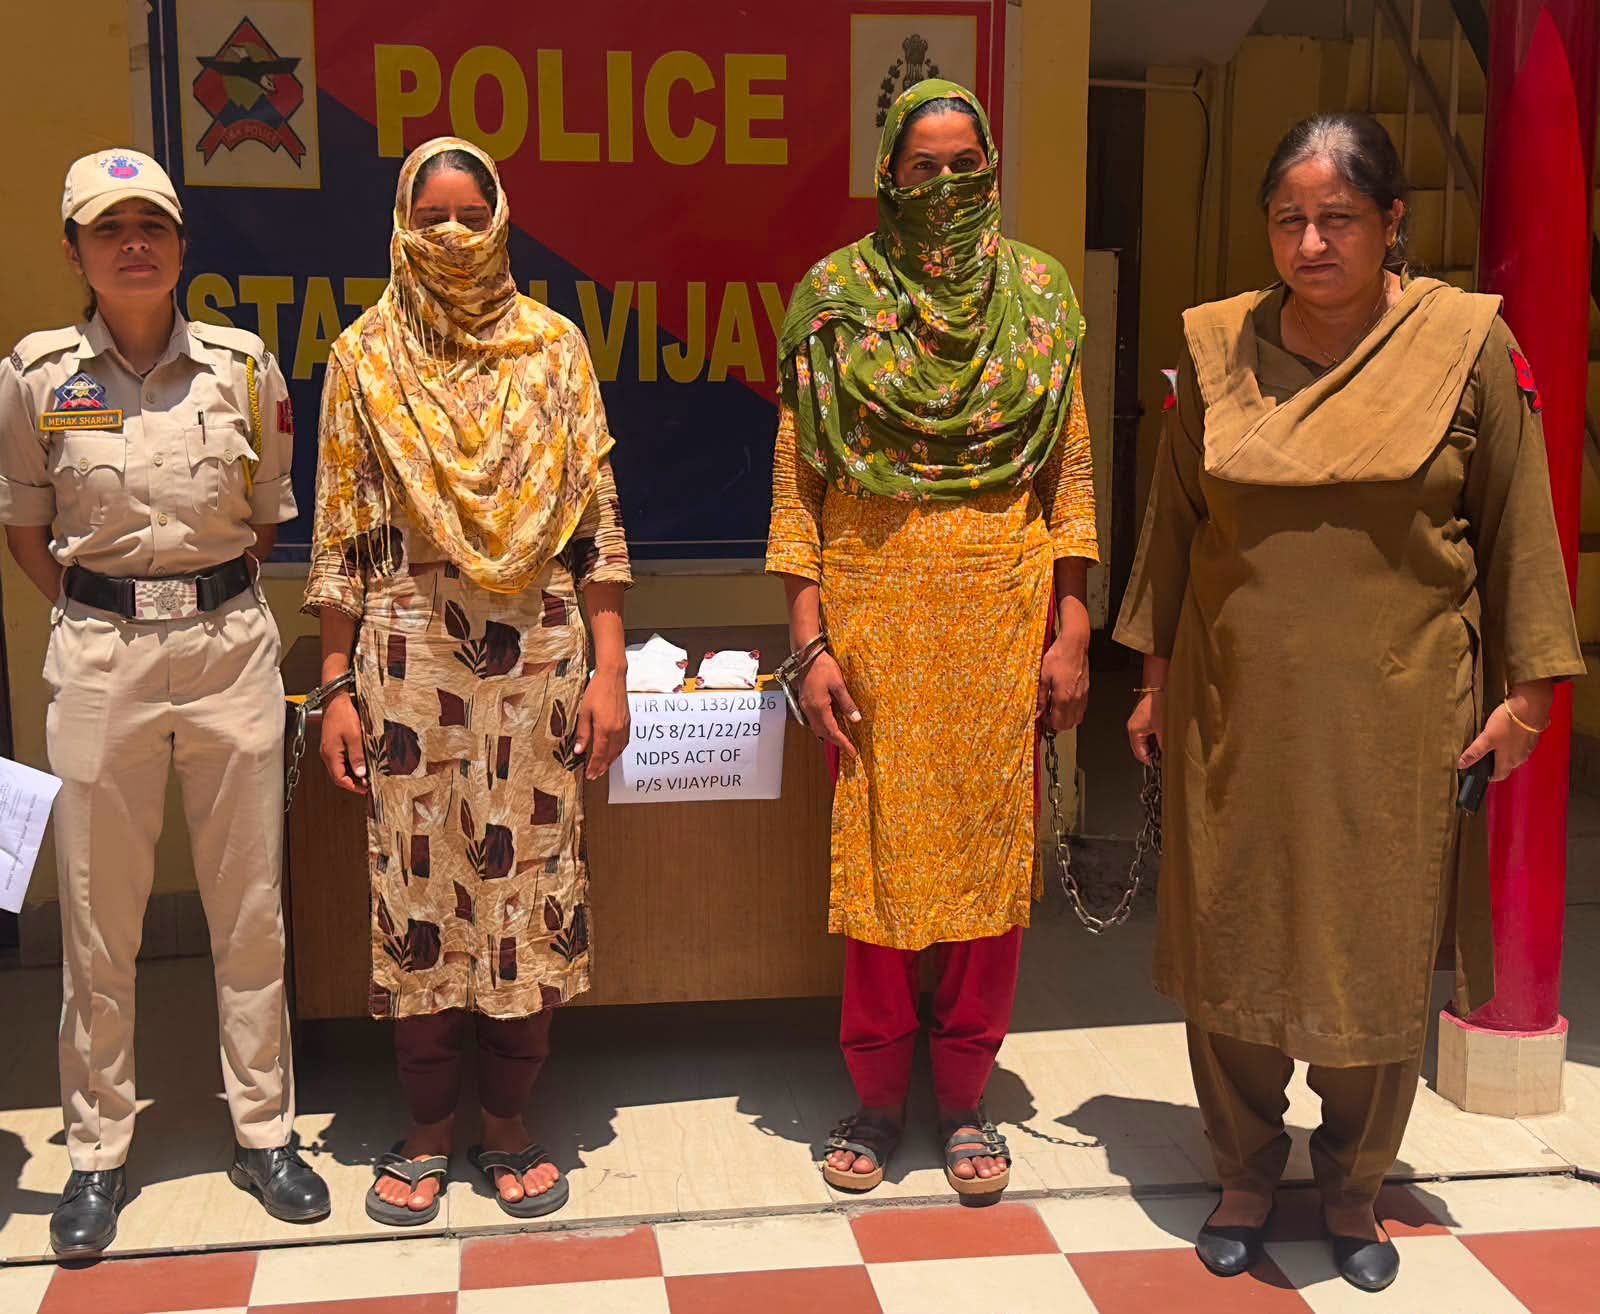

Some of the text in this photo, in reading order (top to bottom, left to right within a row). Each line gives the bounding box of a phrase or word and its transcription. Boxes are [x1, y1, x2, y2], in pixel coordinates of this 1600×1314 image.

[374, 44, 788, 165] POLICE
[48, 415, 114, 427] MEHAK SHARMA
[665, 698, 694, 712] NO.
[700, 697, 776, 713] 133/2026
[636, 722, 761, 741] U/S 8/21/22/29
[636, 749, 742, 766] NDPS ACT OF
[636, 774, 742, 793] P/S VIJAYPUR
